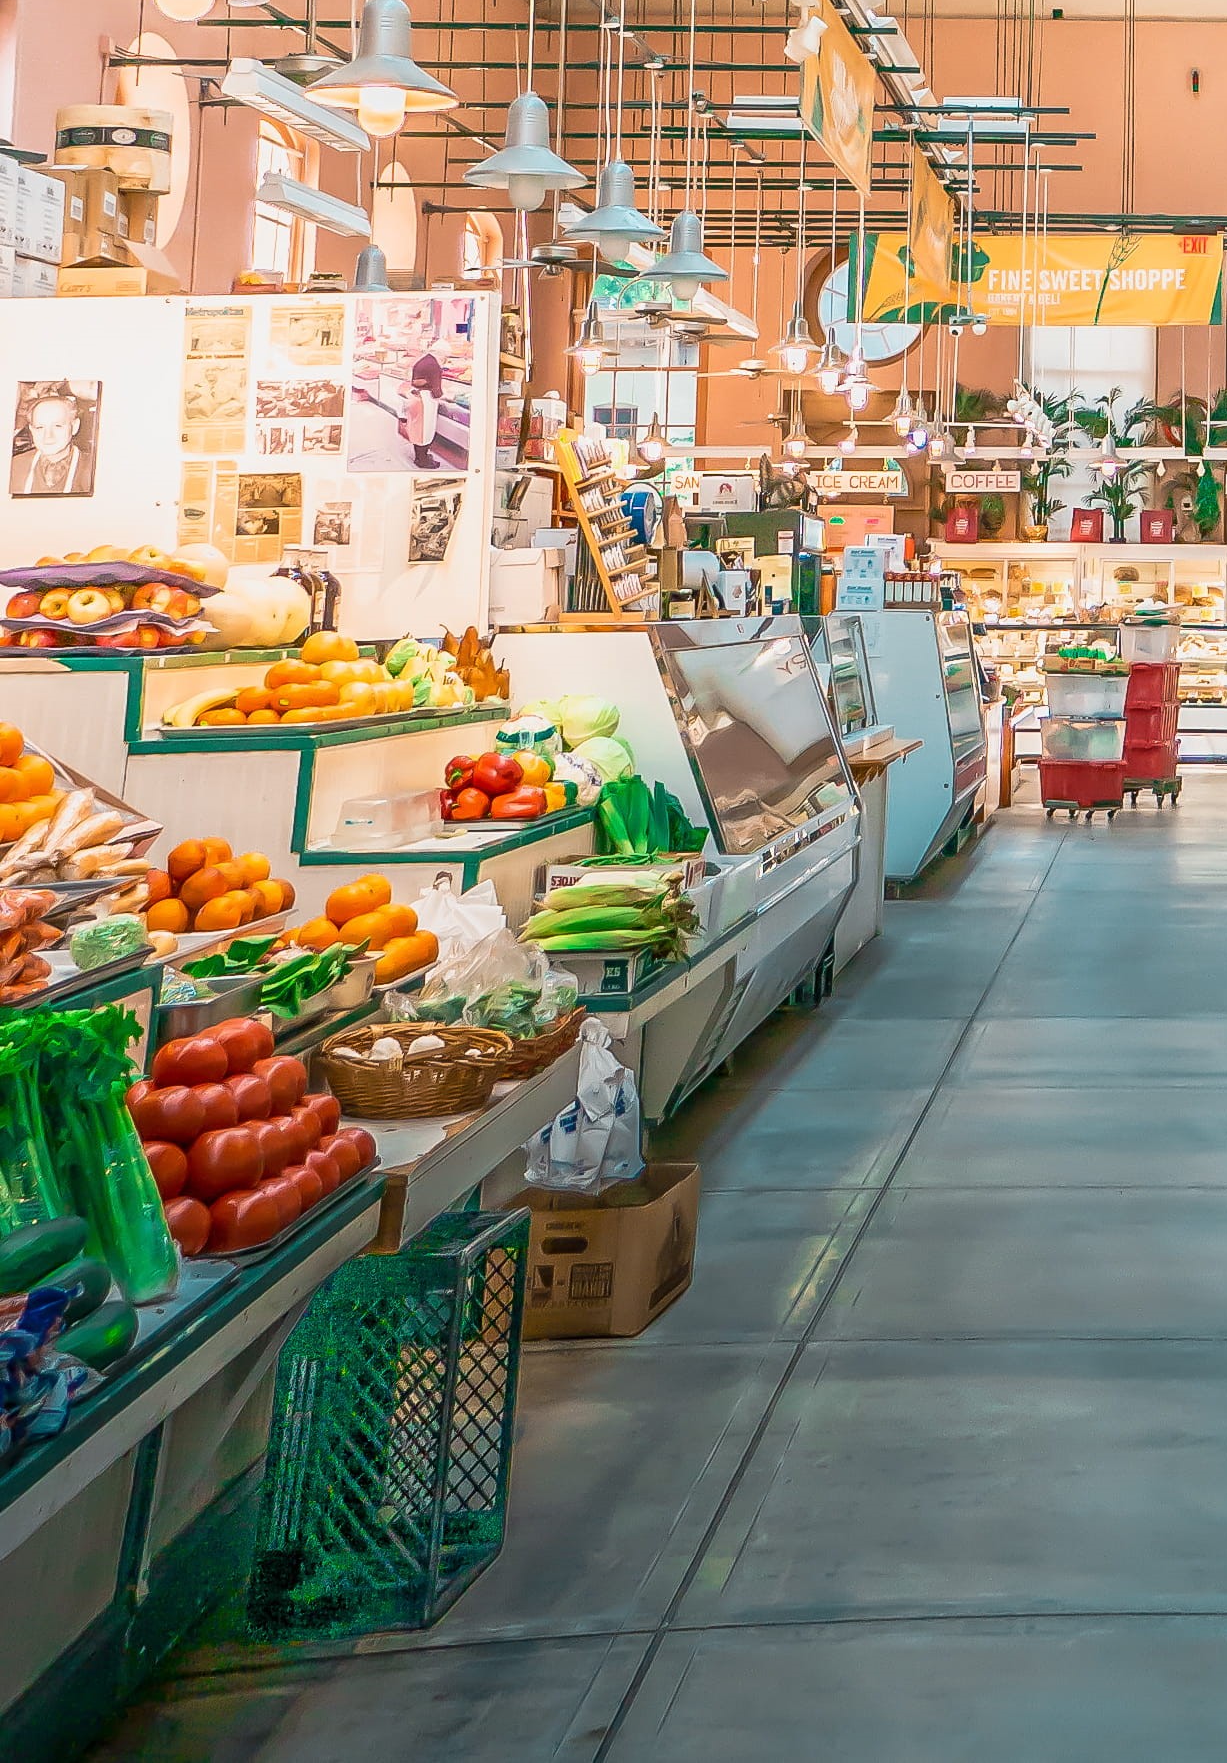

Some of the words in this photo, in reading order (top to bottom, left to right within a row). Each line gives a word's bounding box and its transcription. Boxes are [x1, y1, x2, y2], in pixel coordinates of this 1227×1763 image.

[1183, 237, 1208, 253] EXIT
[988, 269, 1032, 291] FINE
[1039, 269, 1100, 291] SWEET
[1109, 268, 1186, 291] SHOPPE
[1038, 292, 1060, 305] DELI
[816, 475, 842, 488] ICE
[849, 475, 898, 488] CREAM
[951, 474, 1017, 488] COFFEE
